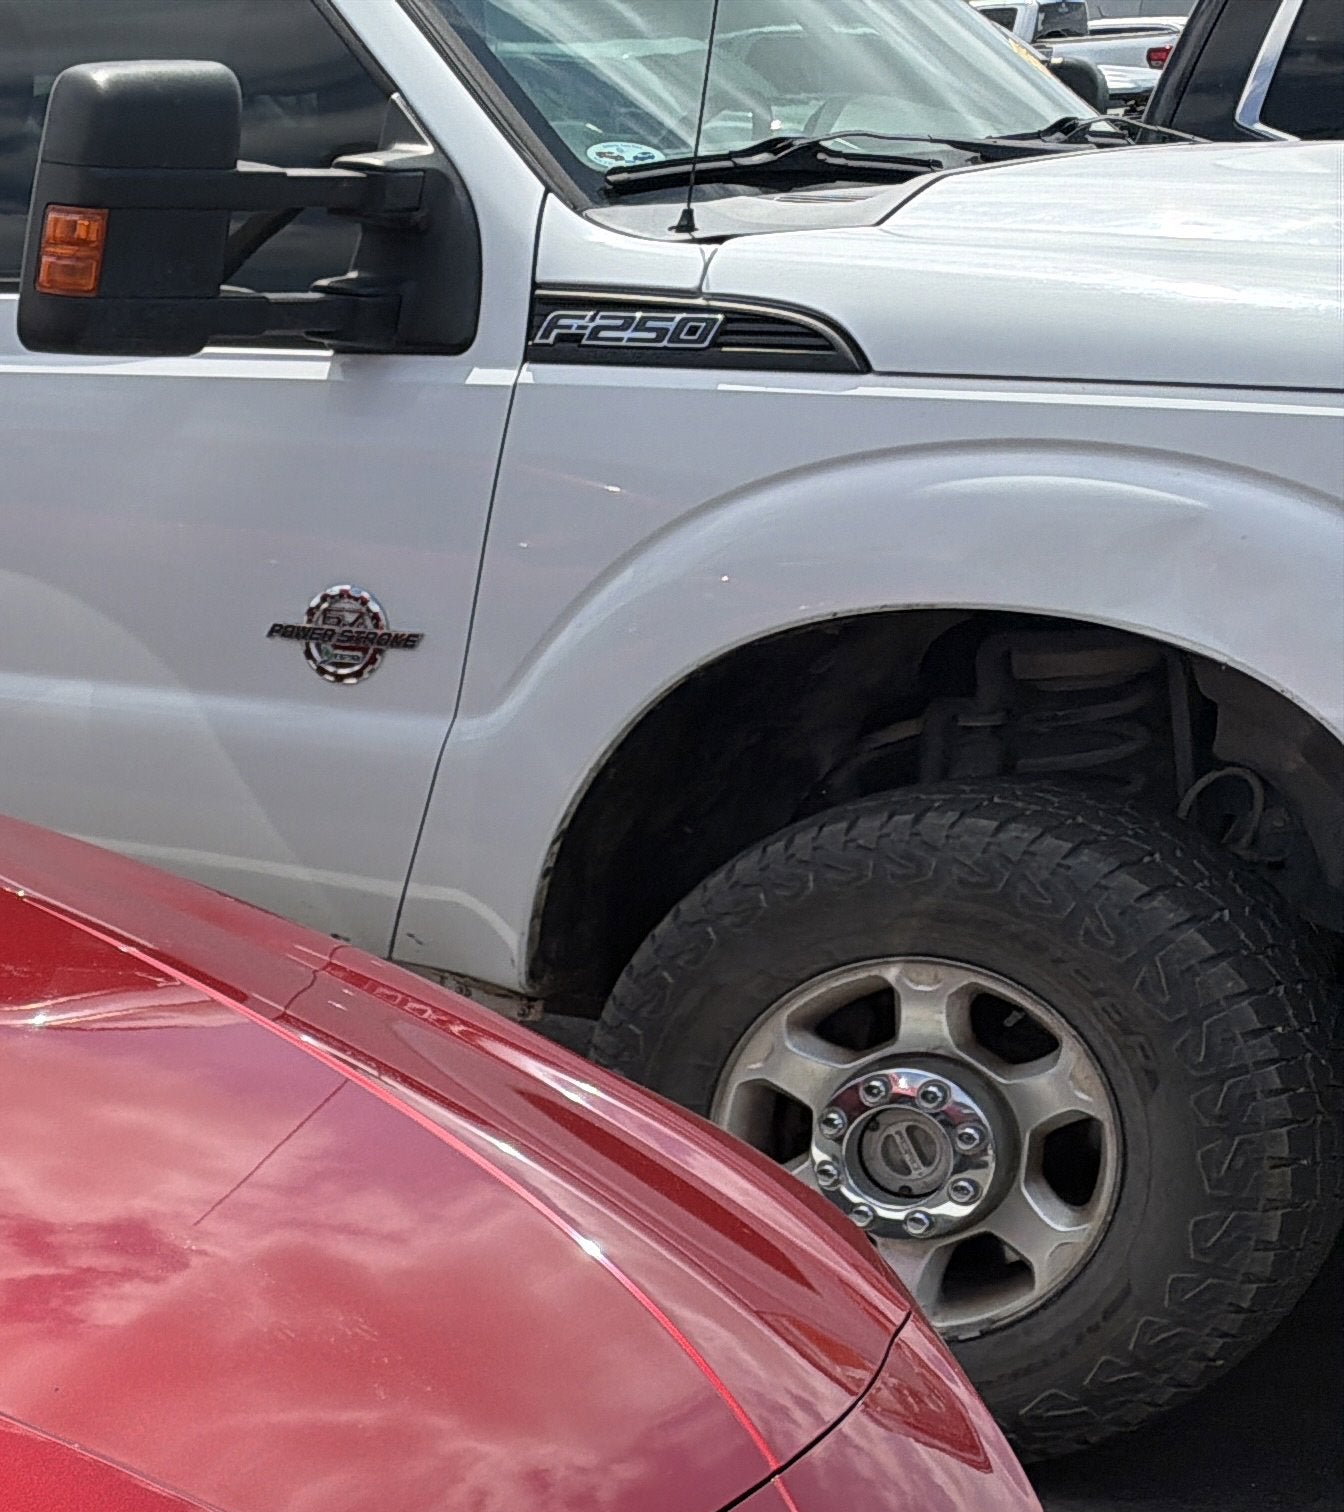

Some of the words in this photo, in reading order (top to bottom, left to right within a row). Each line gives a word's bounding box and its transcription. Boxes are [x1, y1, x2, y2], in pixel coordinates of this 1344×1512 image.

[533, 310, 724, 348] F-250
[267, 623, 336, 643] POWER
[337, 629, 421, 649] STROKE
